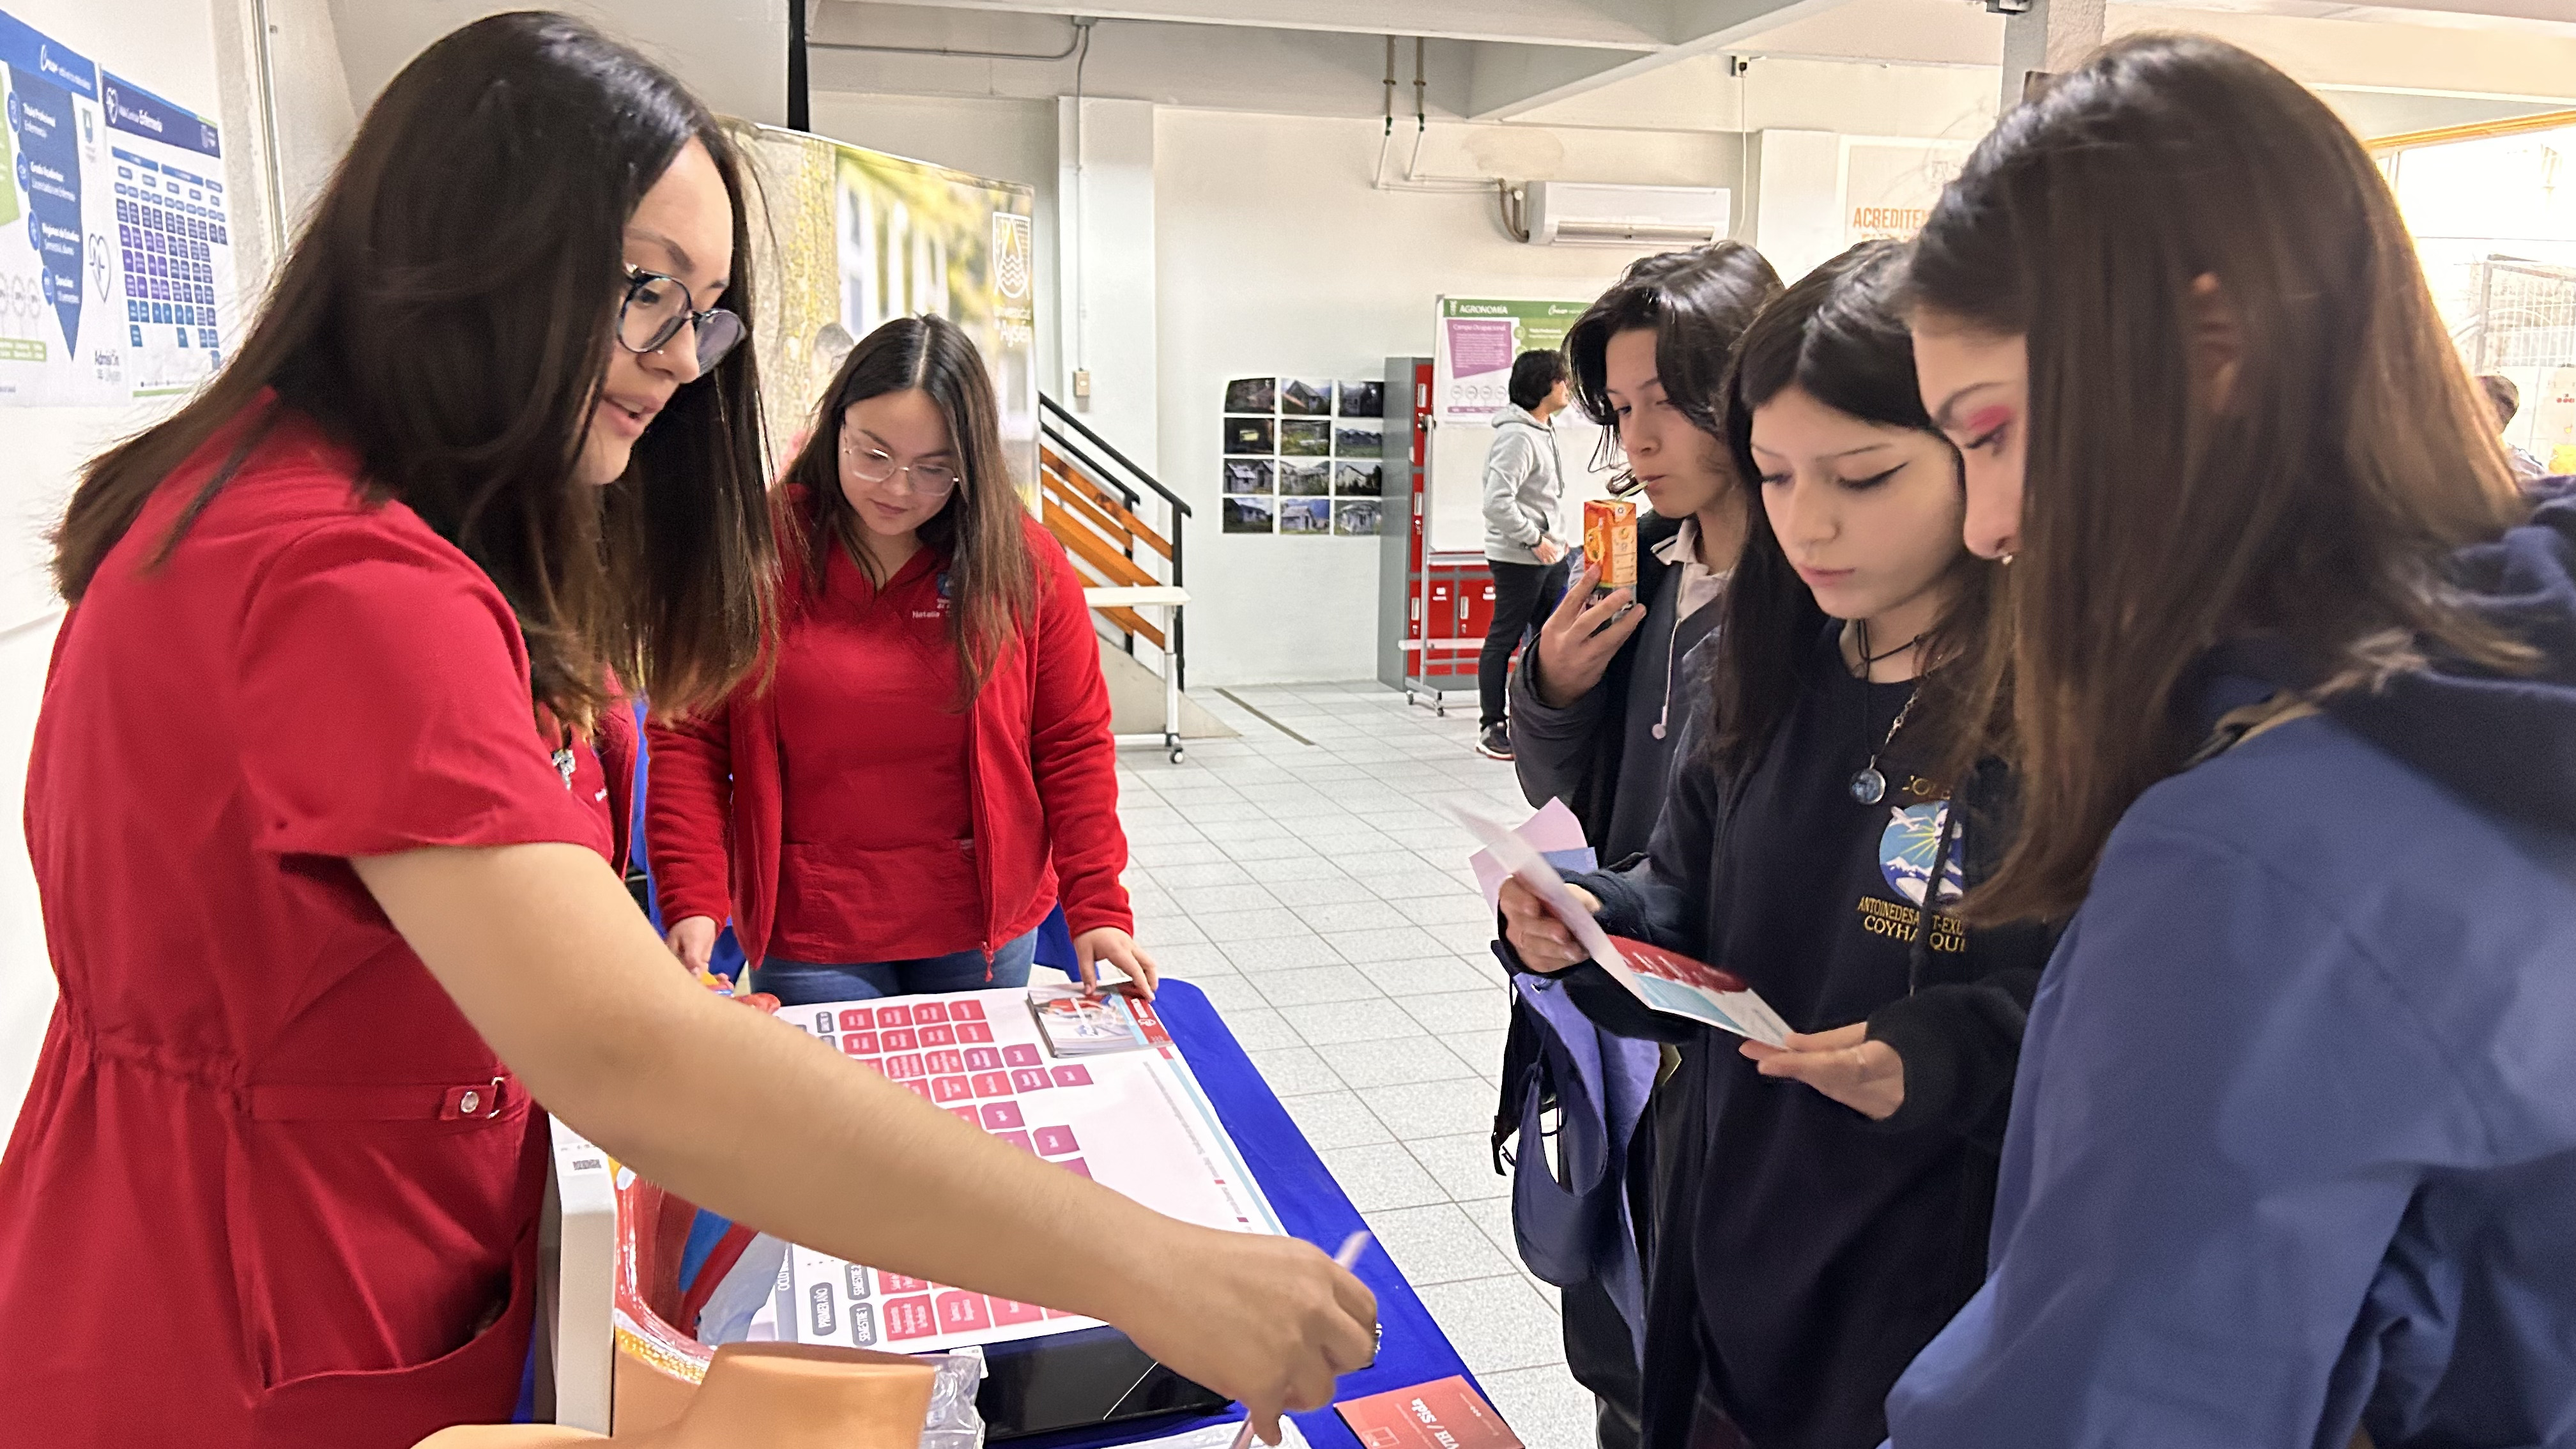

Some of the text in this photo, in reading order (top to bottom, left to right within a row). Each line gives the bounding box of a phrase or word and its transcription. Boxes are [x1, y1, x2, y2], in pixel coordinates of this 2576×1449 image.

[1459, 305, 1508, 314] AGRONOMÍA
[1864, 915, 1966, 952] COYHQU
[852, 1269, 865, 1296] SEMESTRE
[813, 1287, 831, 1329] PRIMER AÑO
[856, 1311, 871, 1342] SEMESTRE
[1411, 1398, 1437, 1423] Sida
[1434, 1429, 1460, 1449] VIH
